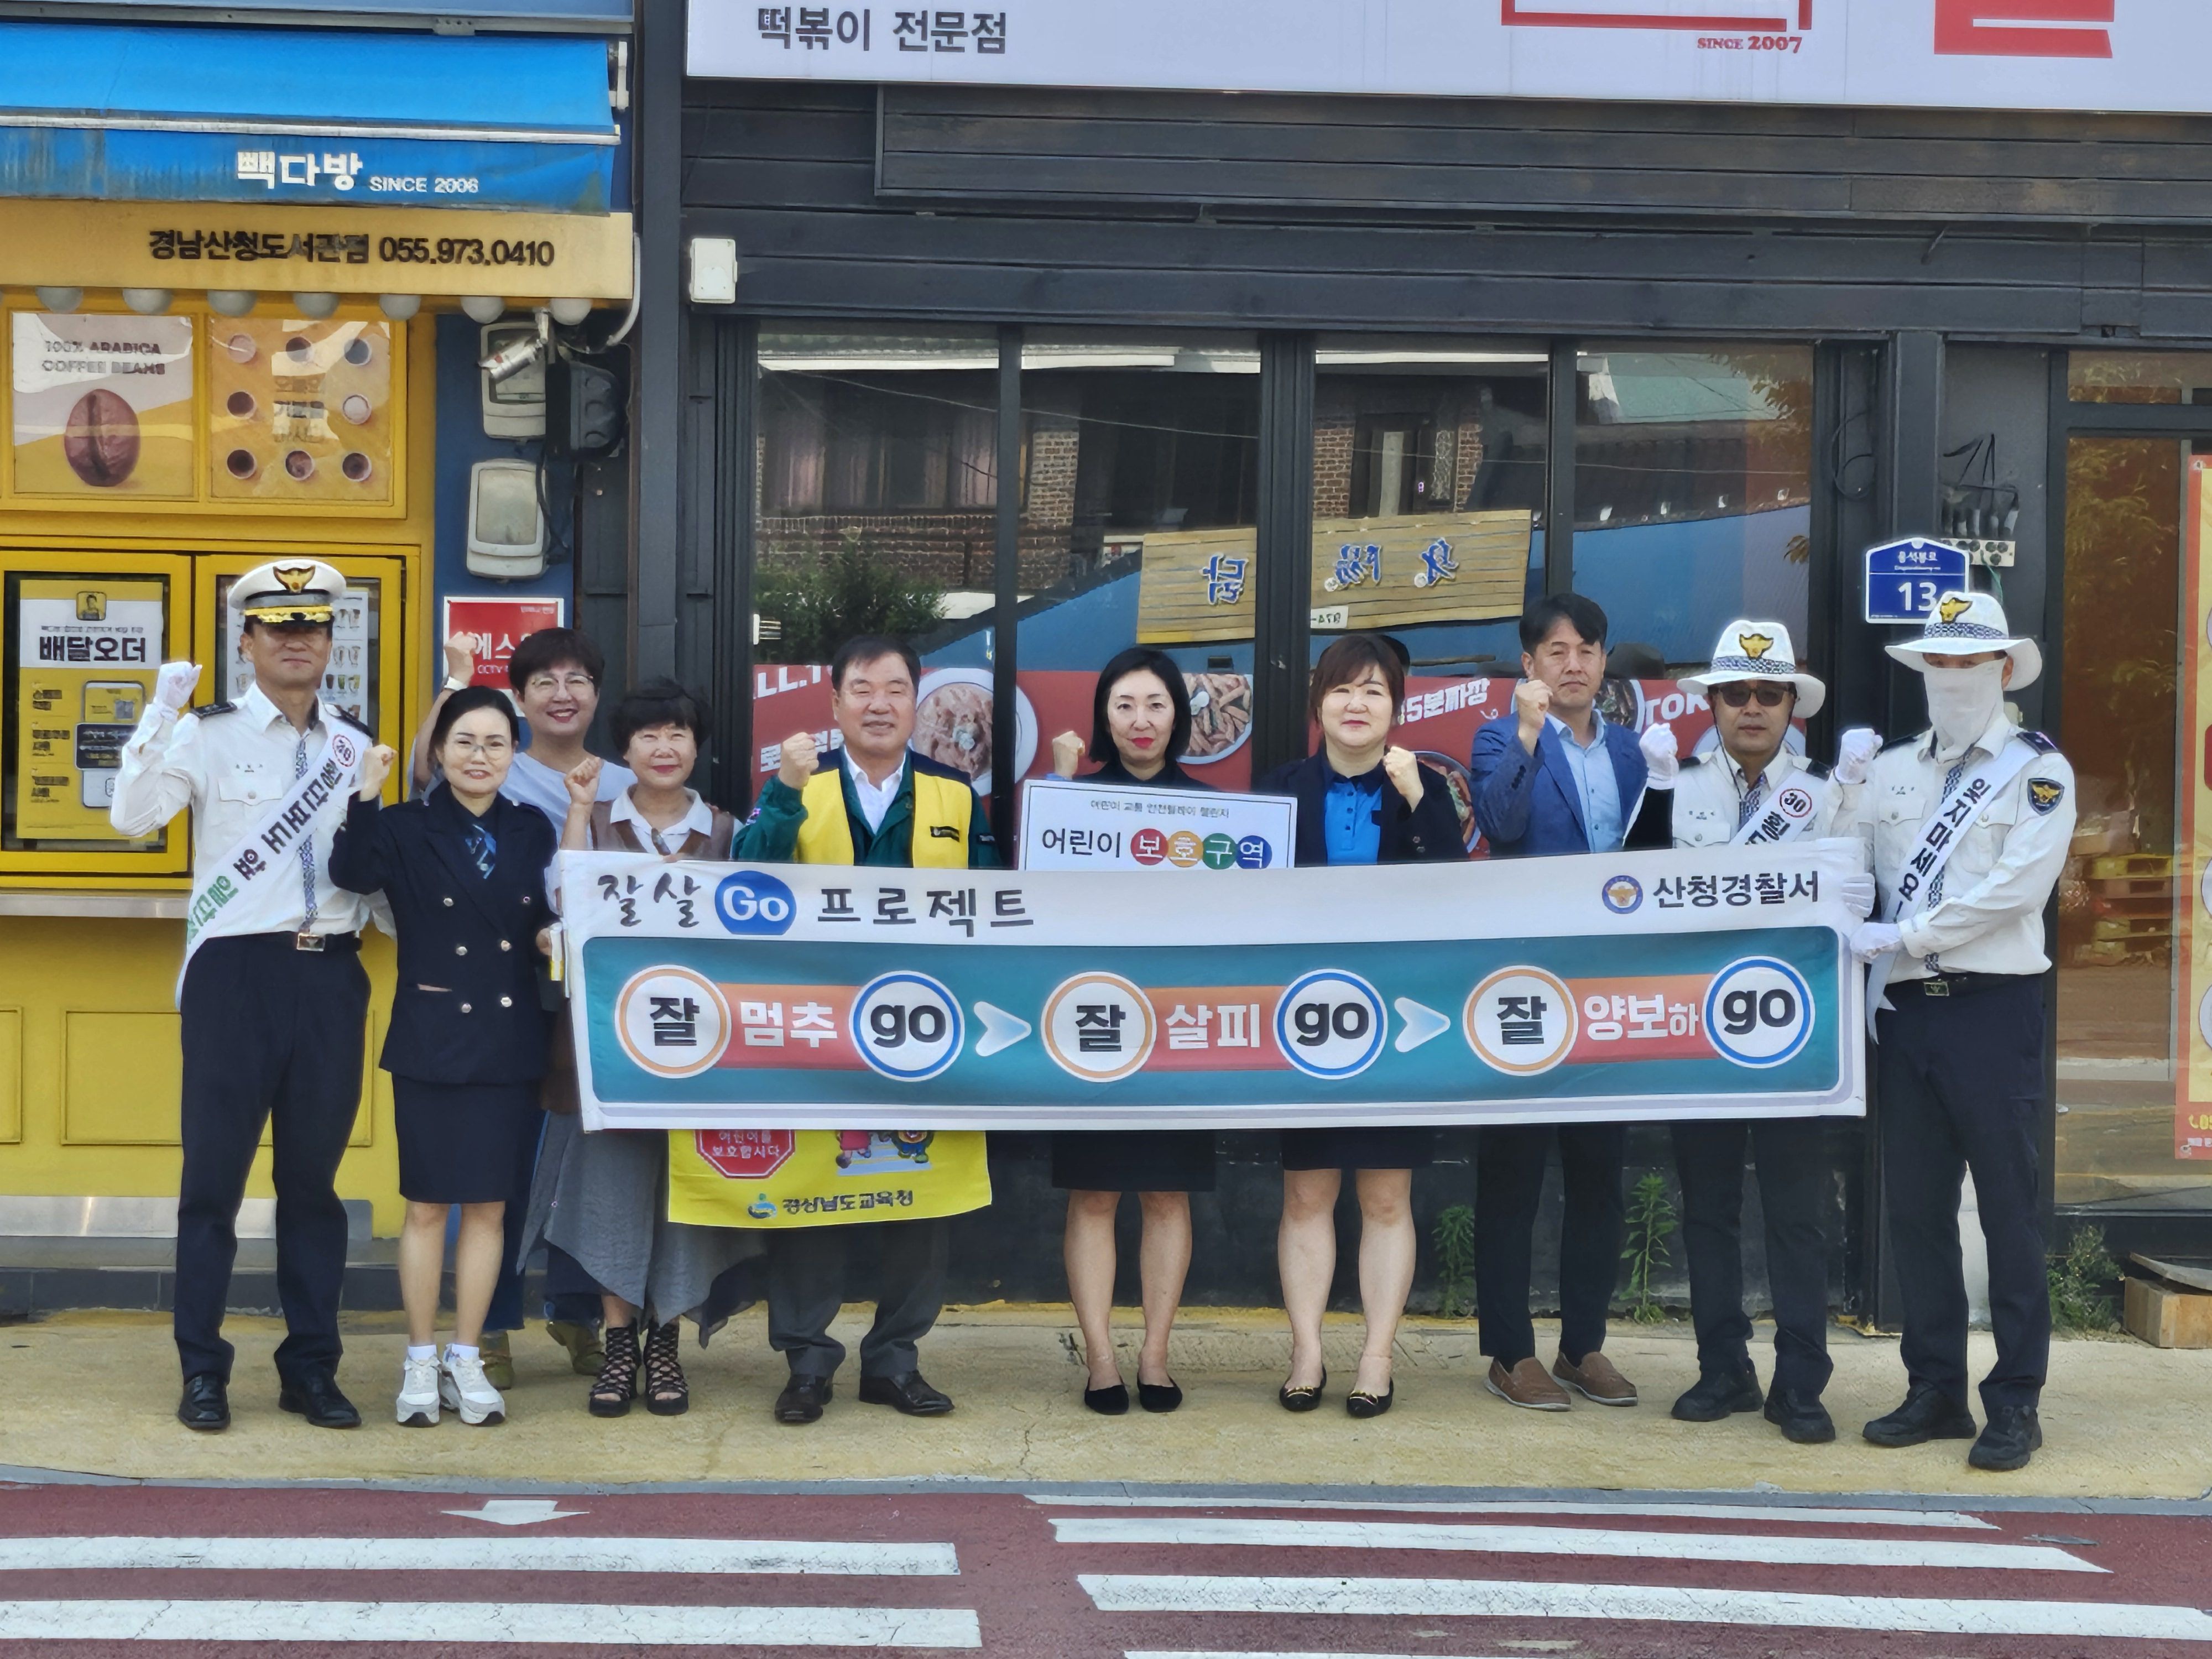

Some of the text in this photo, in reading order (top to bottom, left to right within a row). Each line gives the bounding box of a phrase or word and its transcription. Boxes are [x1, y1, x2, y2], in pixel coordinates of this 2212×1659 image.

[758, 7, 1006, 54] 떡볶이 전문점
[1697, 36, 1803, 54] SINCE 2007
[237, 151, 479, 193] 빽다방 SINCE 2006
[149, 229, 555, 267] 경남산청도서관점 055.973.0410
[1898, 582, 1937, 611] 13
[39, 636, 145, 662] 배달오더
[473, 633, 531, 660] 에스
[1783, 792, 1807, 812] 30
[1042, 828, 1264, 869] 어린이 보호구역
[1653, 870, 1818, 908] 산청경찰서
[818, 888, 1035, 938] 프로젝트
[649, 988, 1796, 1052] 잘 멈추 go 잘 살피 go 잘 양보하 go
[782, 1190, 913, 1214] 경상남도교육청
